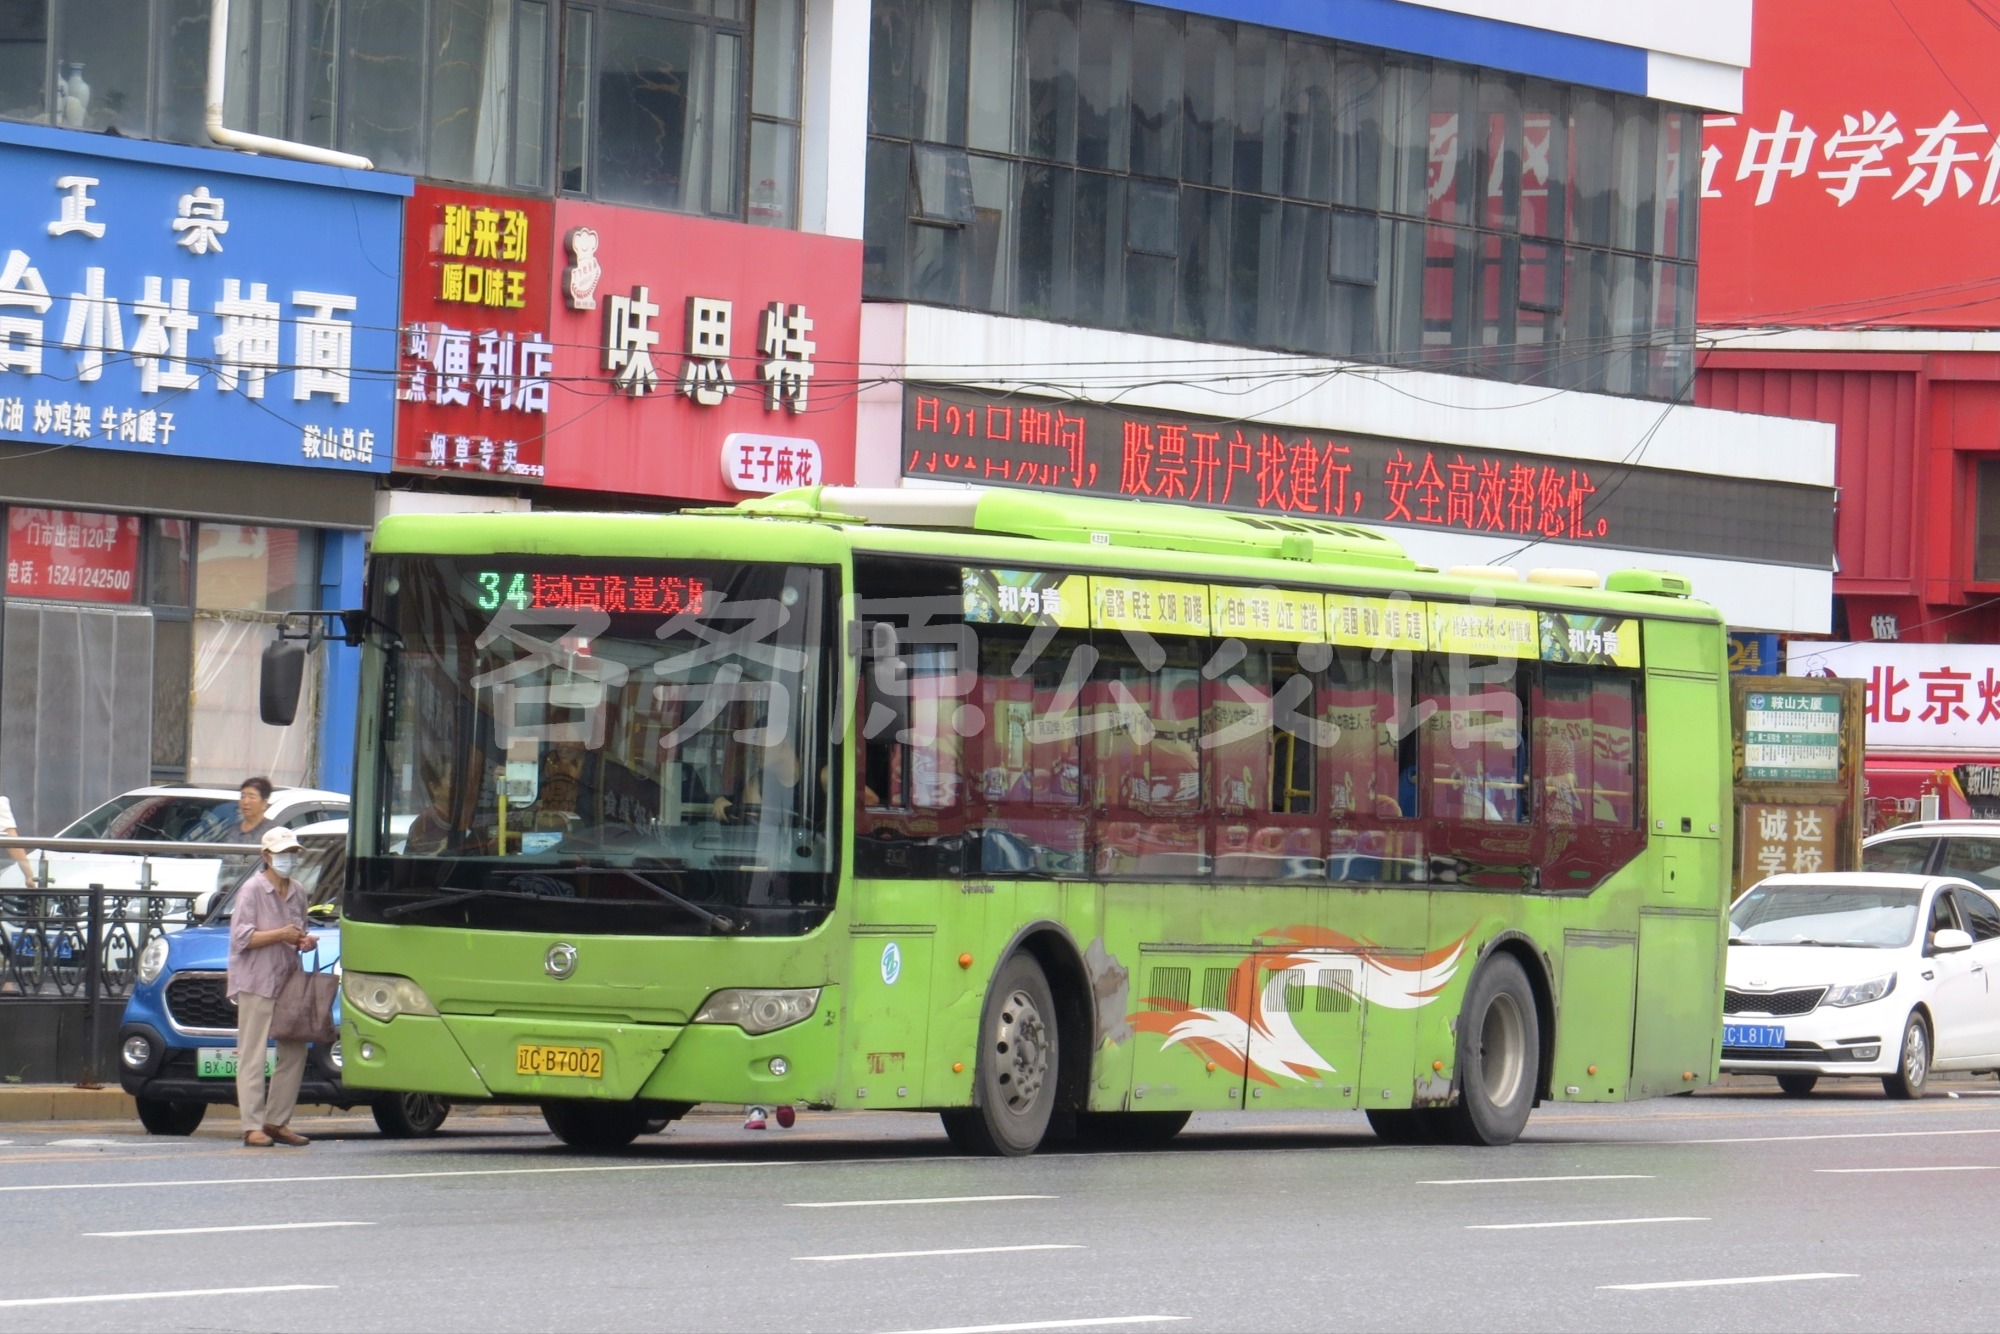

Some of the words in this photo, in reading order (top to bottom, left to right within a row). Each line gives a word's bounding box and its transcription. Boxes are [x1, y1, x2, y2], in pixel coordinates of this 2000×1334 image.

[1667, 110, 2000, 206] 五中学东
[47, 176, 229, 254] 正宗
[443, 204, 529, 263] 秒来劲
[442, 264, 527, 309] 嚼口味王
[406, 323, 430, 402] 站点
[432, 324, 553, 414] 便利店
[604, 286, 816, 415] 味思特
[33, 399, 91, 438] 炒鸡架
[101, 405, 176, 445] 牛肉腱子
[302, 424, 375, 464] 鞍山总店
[430, 433, 518, 471] 烟草专卖
[738, 445, 813, 487] 王子麻花
[27, 522, 117, 551] 门市出租120平
[478, 572, 528, 610] 34
[997, 585, 1062, 615] 和为贵
[1568, 628, 1619, 656] 和为贵
[1771, 696, 1823, 711] 鞍山大厦
[1758, 809, 1822, 842] 诚达
[1758, 847, 1822, 877] 学校
